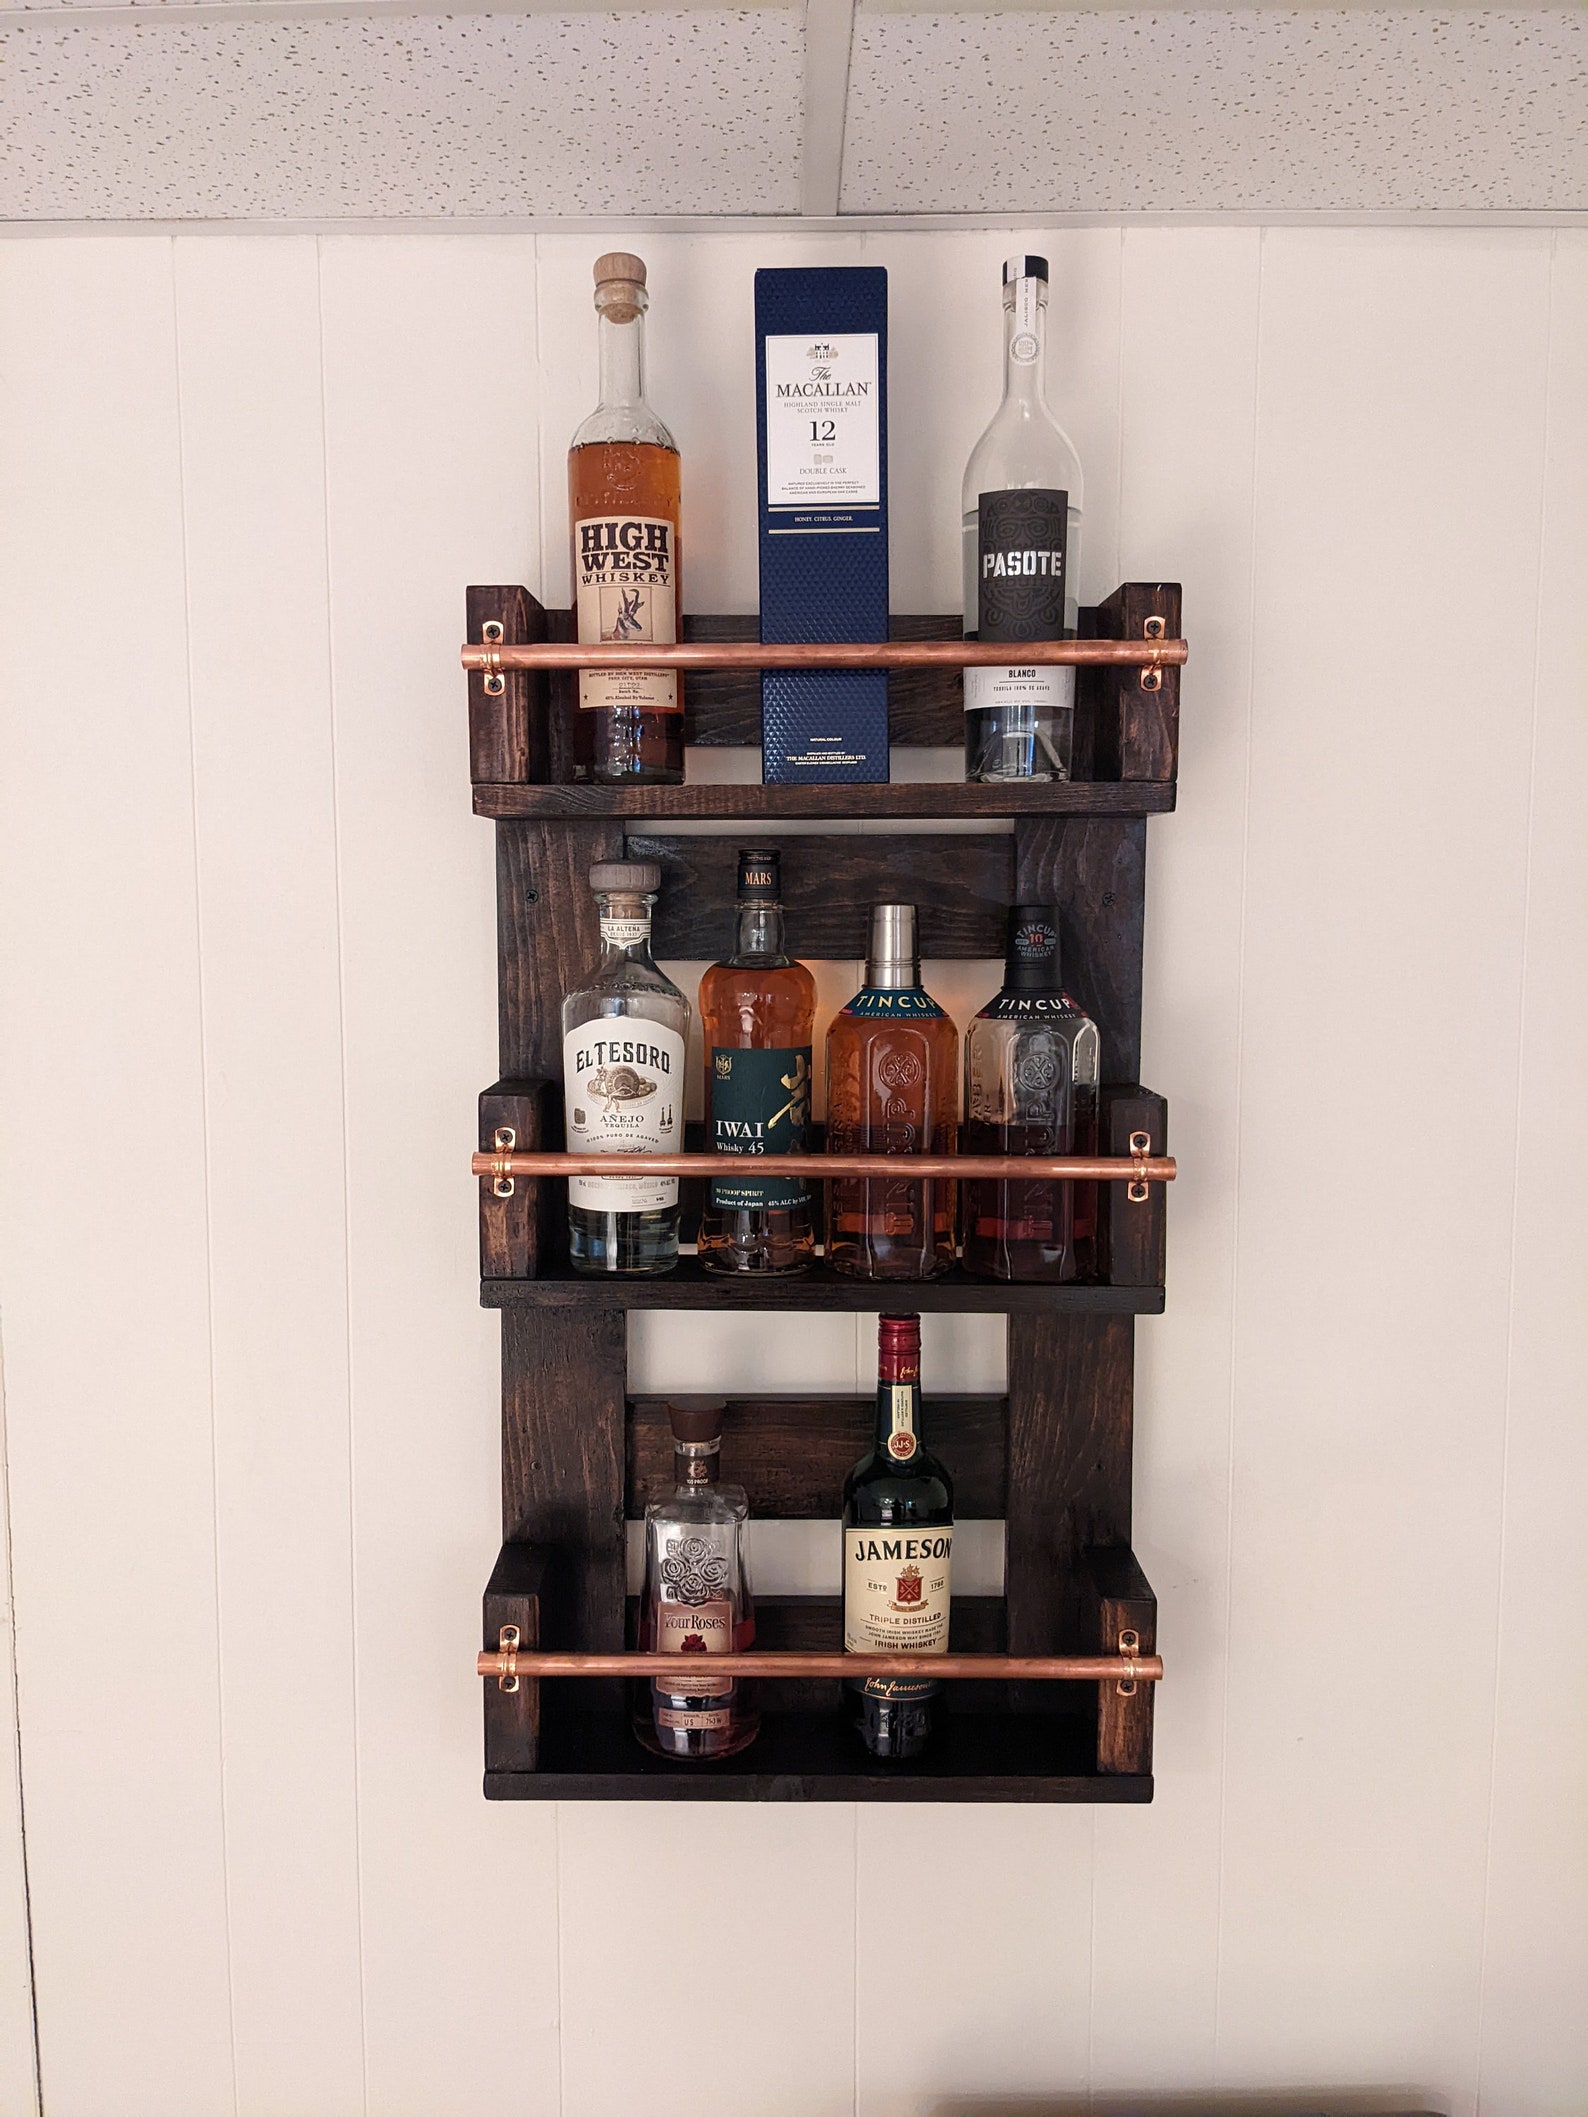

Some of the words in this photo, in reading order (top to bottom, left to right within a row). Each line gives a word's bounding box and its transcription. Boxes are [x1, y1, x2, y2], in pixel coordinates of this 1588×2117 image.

[809, 366, 832, 382] The
[776, 382, 870, 398] MACALLAN
[809, 420, 836, 442] 12
[581, 522, 668, 553] HIGH
[582, 552, 669, 572] WEST
[983, 551, 1062, 579] PASOTE
[582, 573, 669, 584] WHISKEY
[1008, 669, 1036, 678] BLANCO
[745, 872, 772, 885] MARS
[1017, 924, 1056, 938] TINCUP
[1030, 934, 1044, 944] 10
[856, 995, 936, 1009] TINCUP
[998, 998, 1072, 1010] TINCUP
[576, 1050, 594, 1074] EL
[594, 1042, 670, 1075] TESORO
[600, 1114, 644, 1123] AÑEJO
[716, 1120, 764, 1138] IWAI
[716, 1142, 744, 1154] Whisky
[748, 1142, 764, 1155] 45
[716, 1198, 736, 1206] Product
[855, 1538, 952, 1561] JAMESON
[664, 1613, 692, 1629] Four
[691, 1614, 726, 1630] Roses
[870, 1614, 900, 1624] TRIPLE
[903, 1612, 942, 1624] DISTILLED
[865, 1625, 885, 1633] SMOOTH
[875, 1640, 899, 1649] IRISH
[900, 1638, 937, 1649] WHISKEY
[864, 1677, 887, 1691] John
[886, 1680, 932, 1696] Jameson
